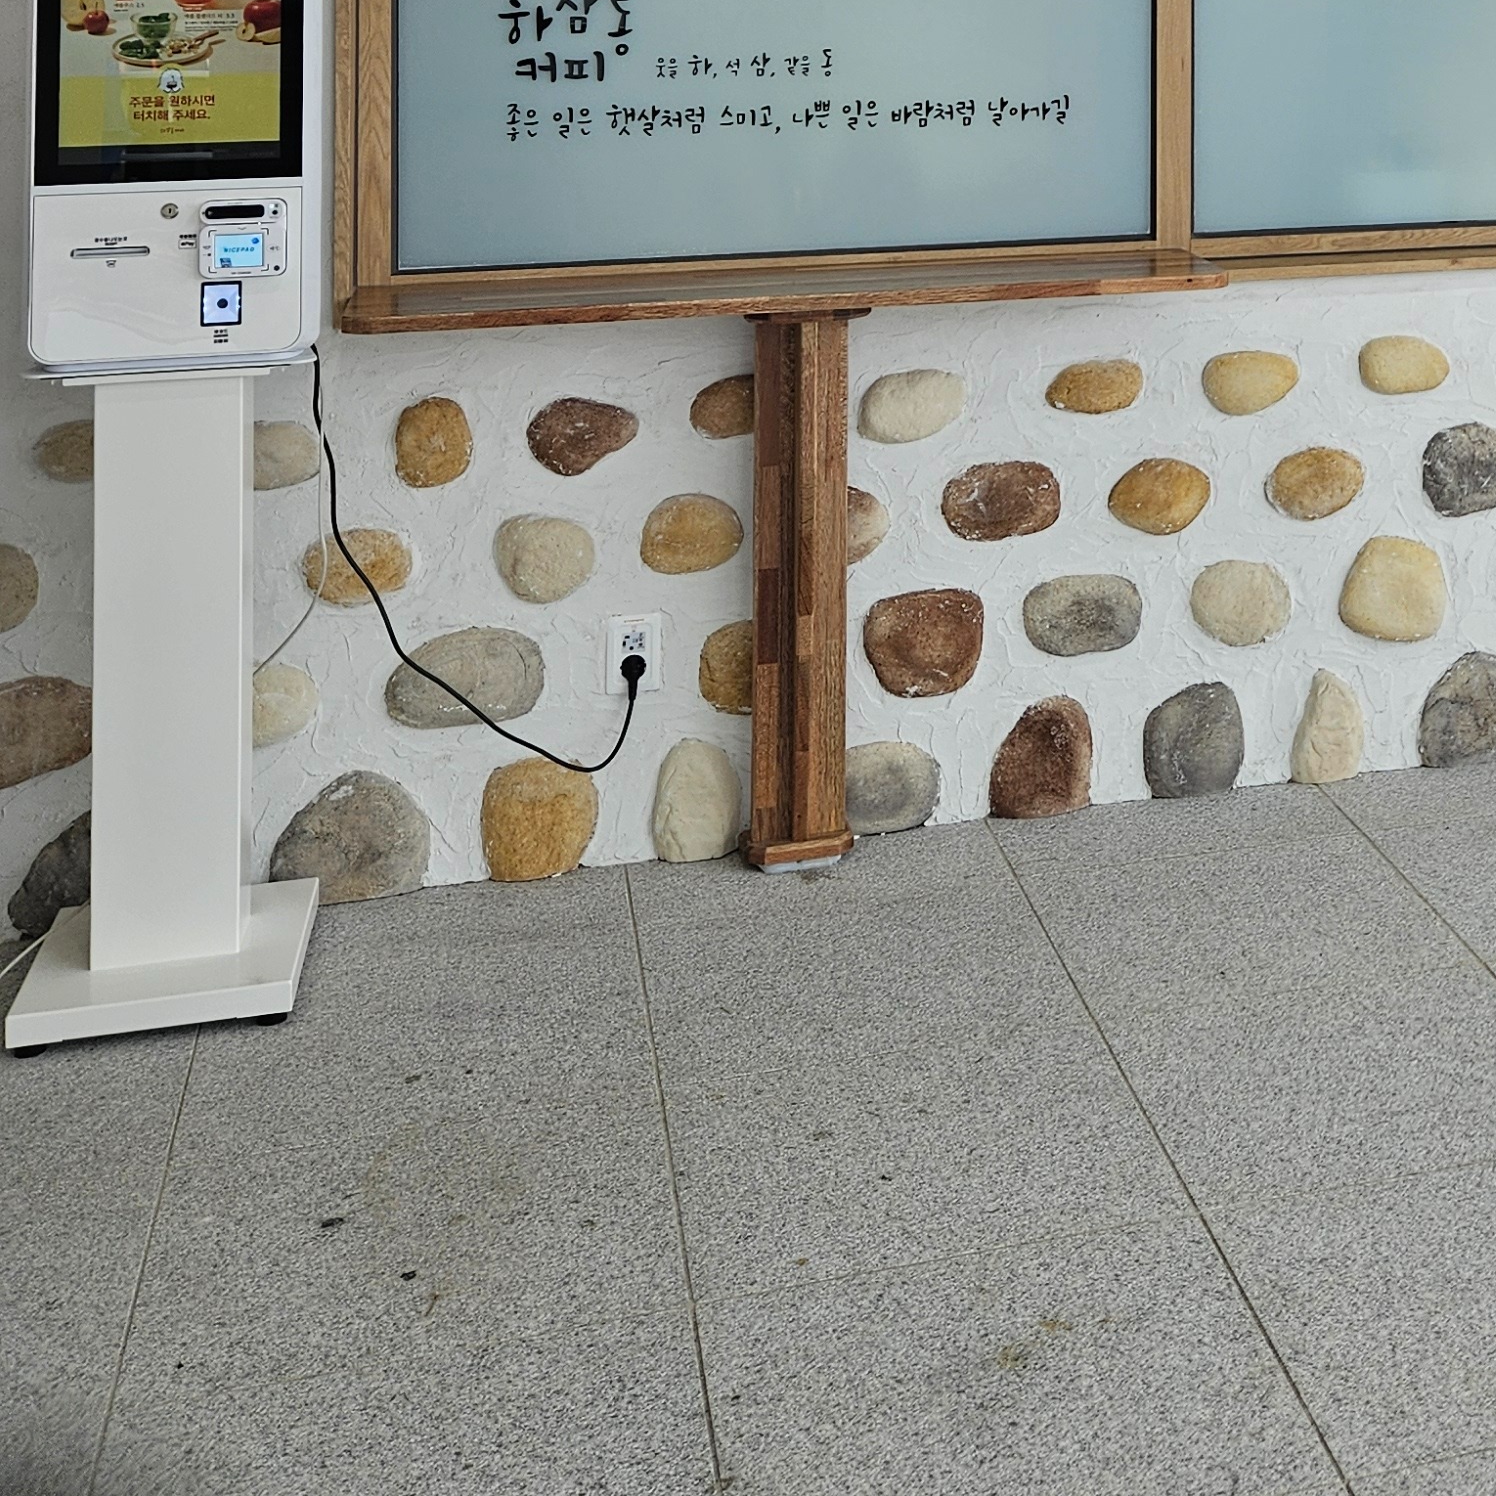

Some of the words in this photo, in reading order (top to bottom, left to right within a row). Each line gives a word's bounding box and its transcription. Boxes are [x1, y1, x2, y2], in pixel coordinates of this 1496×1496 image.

[515, 52, 605, 83] 커피
[655, 57, 678, 79] 웃을
[726, 58, 740, 76] 석
[821, 48, 833, 77] 동
[129, 95, 165, 108] 주문을
[169, 94, 215, 106] 원하시면
[134, 110, 168, 122] 터치해
[172, 109, 210, 121] 주세요.
[506, 103, 539, 141] 좋은
[552, 107, 592, 138] 일은
[606, 104, 705, 136] 햇살처럼
[719, 104, 781, 134] 스미고,
[793, 99, 830, 129] 나쁜
[842, 100, 878, 130] 일은
[891, 99, 975, 127] 바람처럼
[988, 94, 1070, 126] 날아가길
